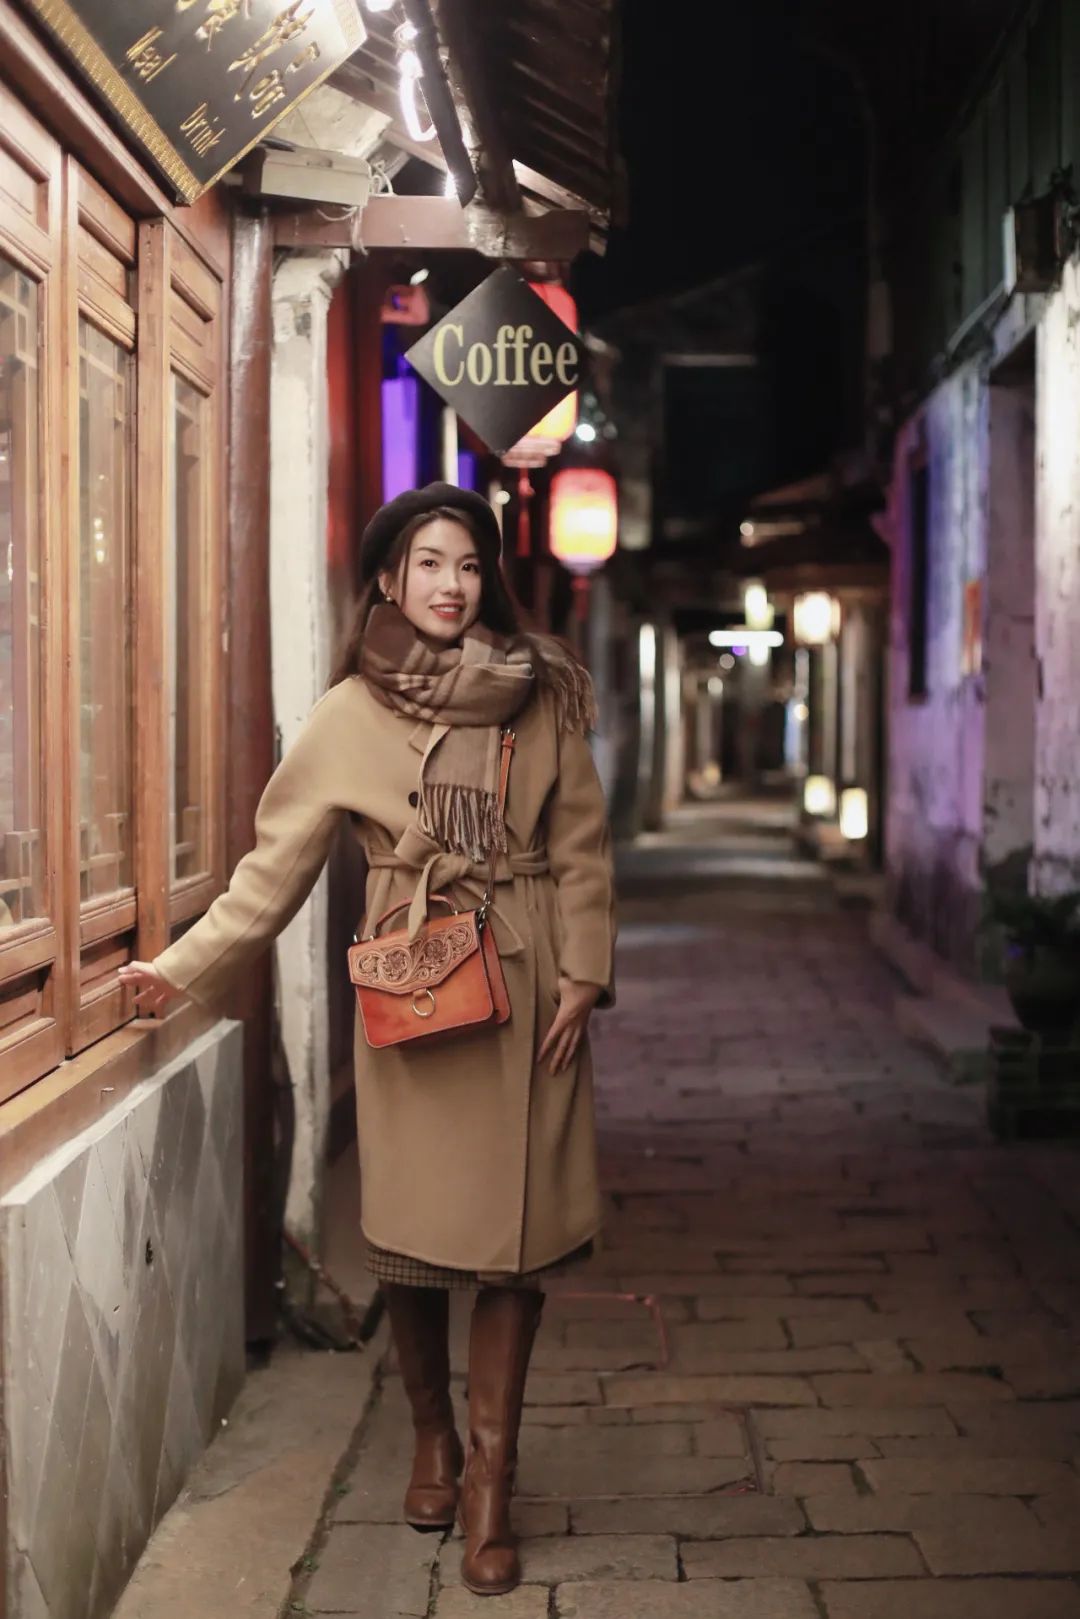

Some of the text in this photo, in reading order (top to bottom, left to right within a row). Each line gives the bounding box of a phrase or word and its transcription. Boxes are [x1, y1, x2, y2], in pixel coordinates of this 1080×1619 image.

[126, 26, 178, 84] Meal
[180, 102, 226, 158] Drink
[432, 323, 579, 386] Coffee
